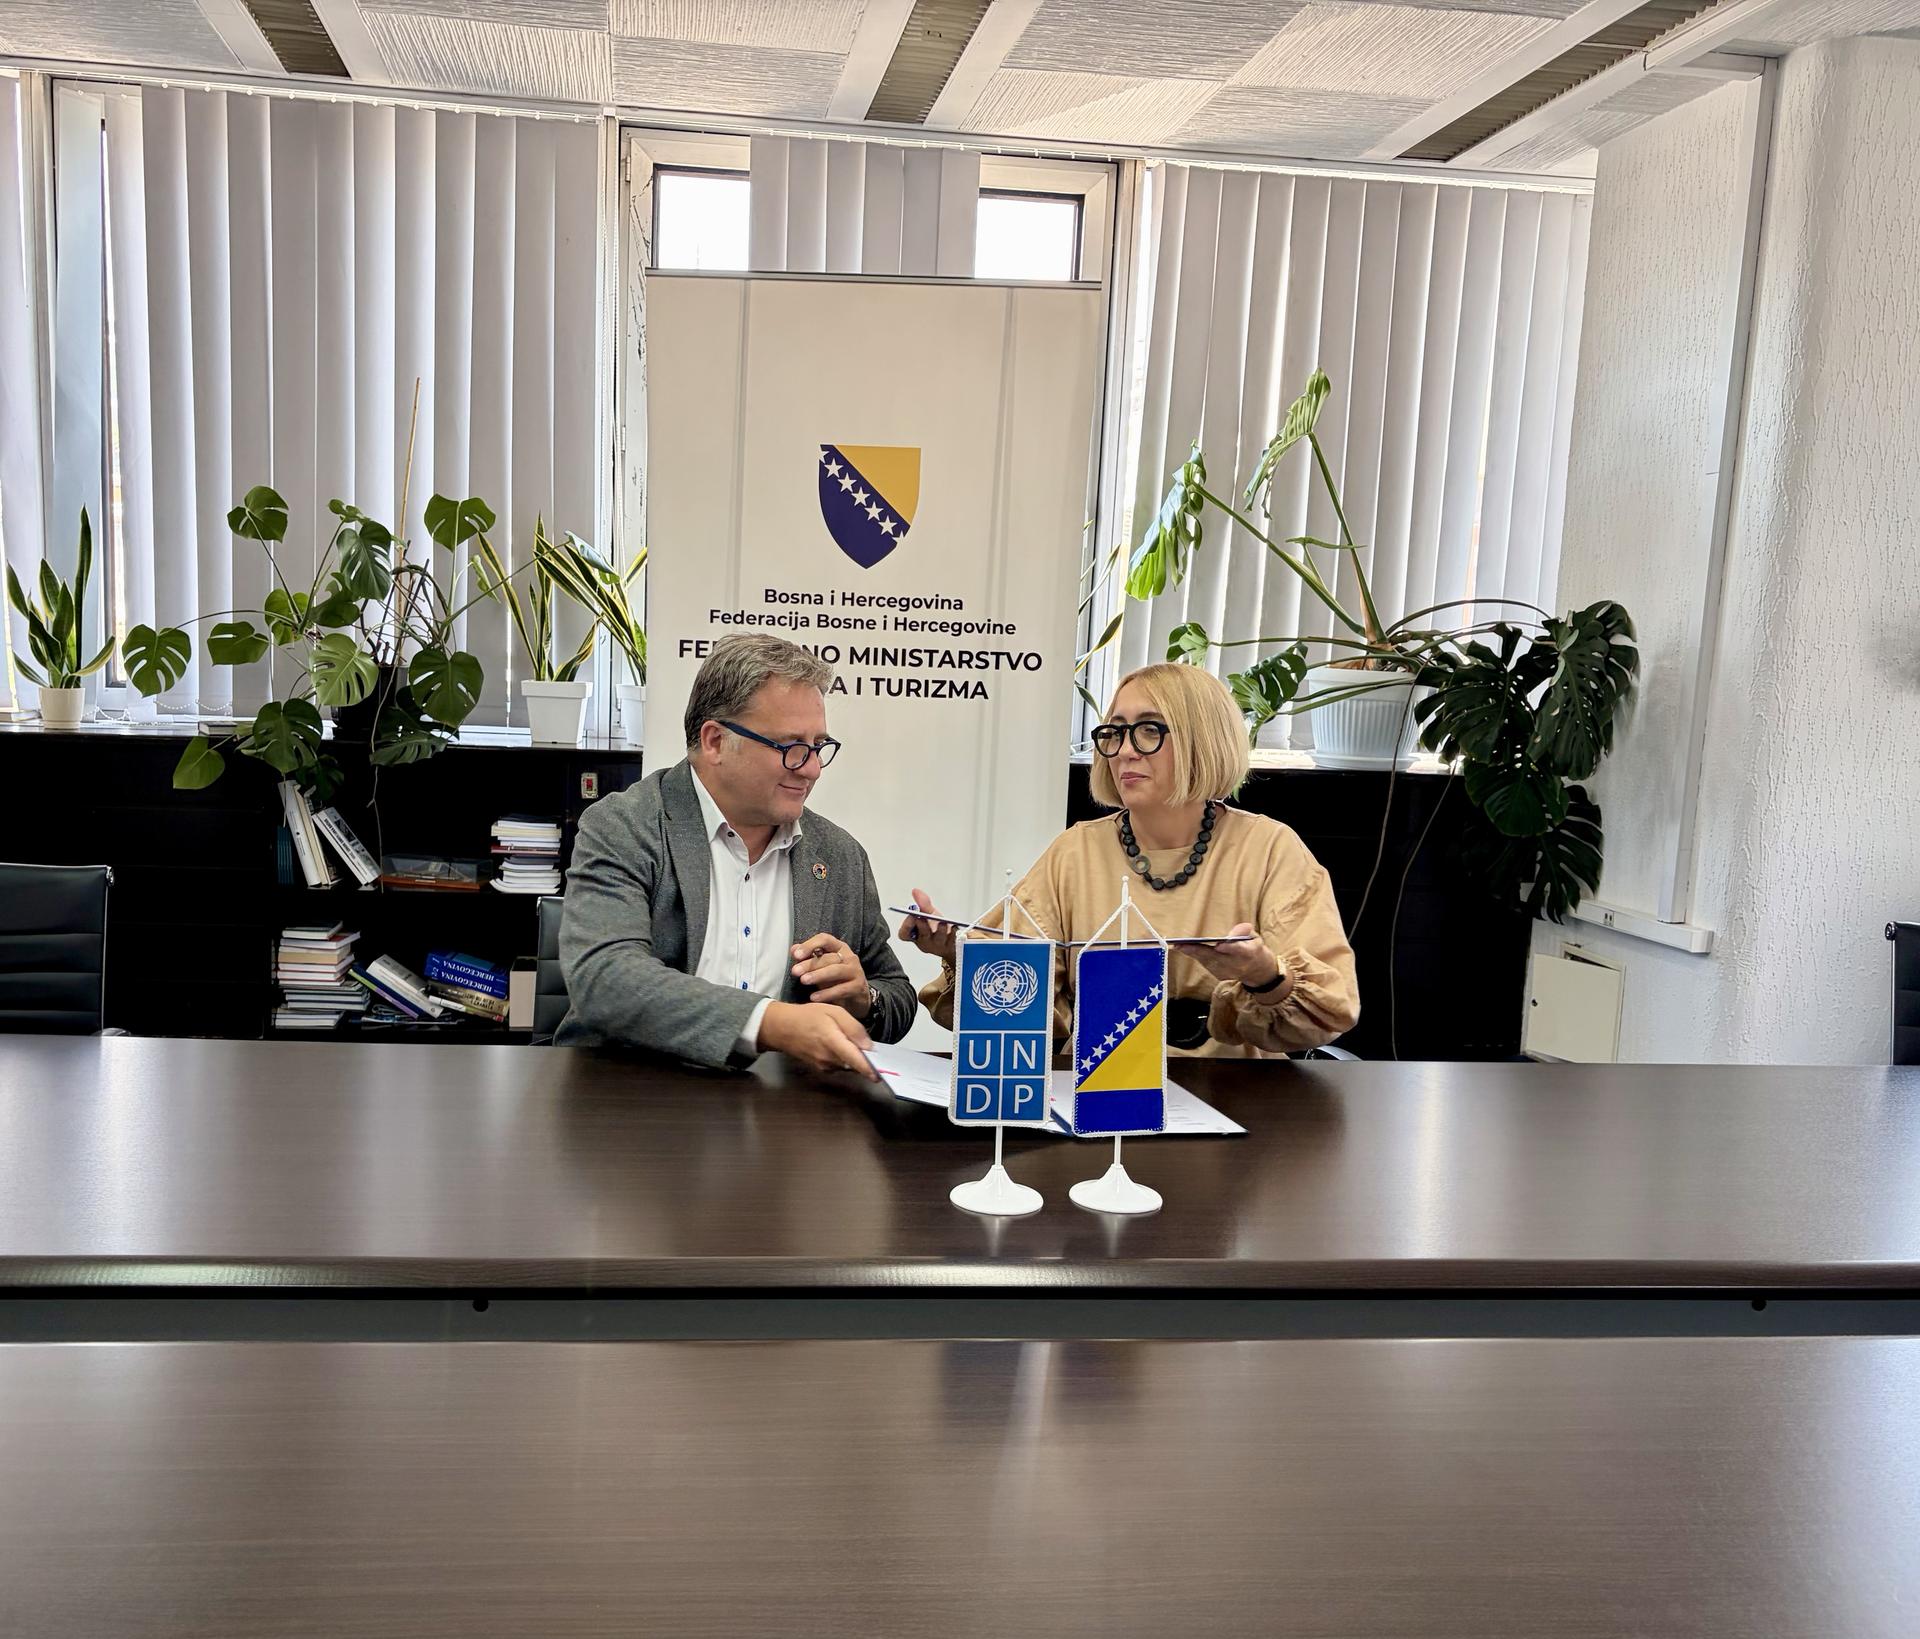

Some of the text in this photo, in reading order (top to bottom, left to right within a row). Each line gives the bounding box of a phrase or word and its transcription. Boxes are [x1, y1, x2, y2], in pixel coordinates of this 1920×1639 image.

[764, 588, 964, 613] Bosna i Hercegovina
[709, 609, 1017, 637] Federacija Bosne i Hercegovine
[849, 645, 1043, 672] MINISTARSTVO
[856, 676, 862, 696] I
[870, 677, 989, 700] TURIZMA
[441, 971, 493, 993] HERCEGOVINA
[443, 960, 494, 982] HERCEGOVINA
